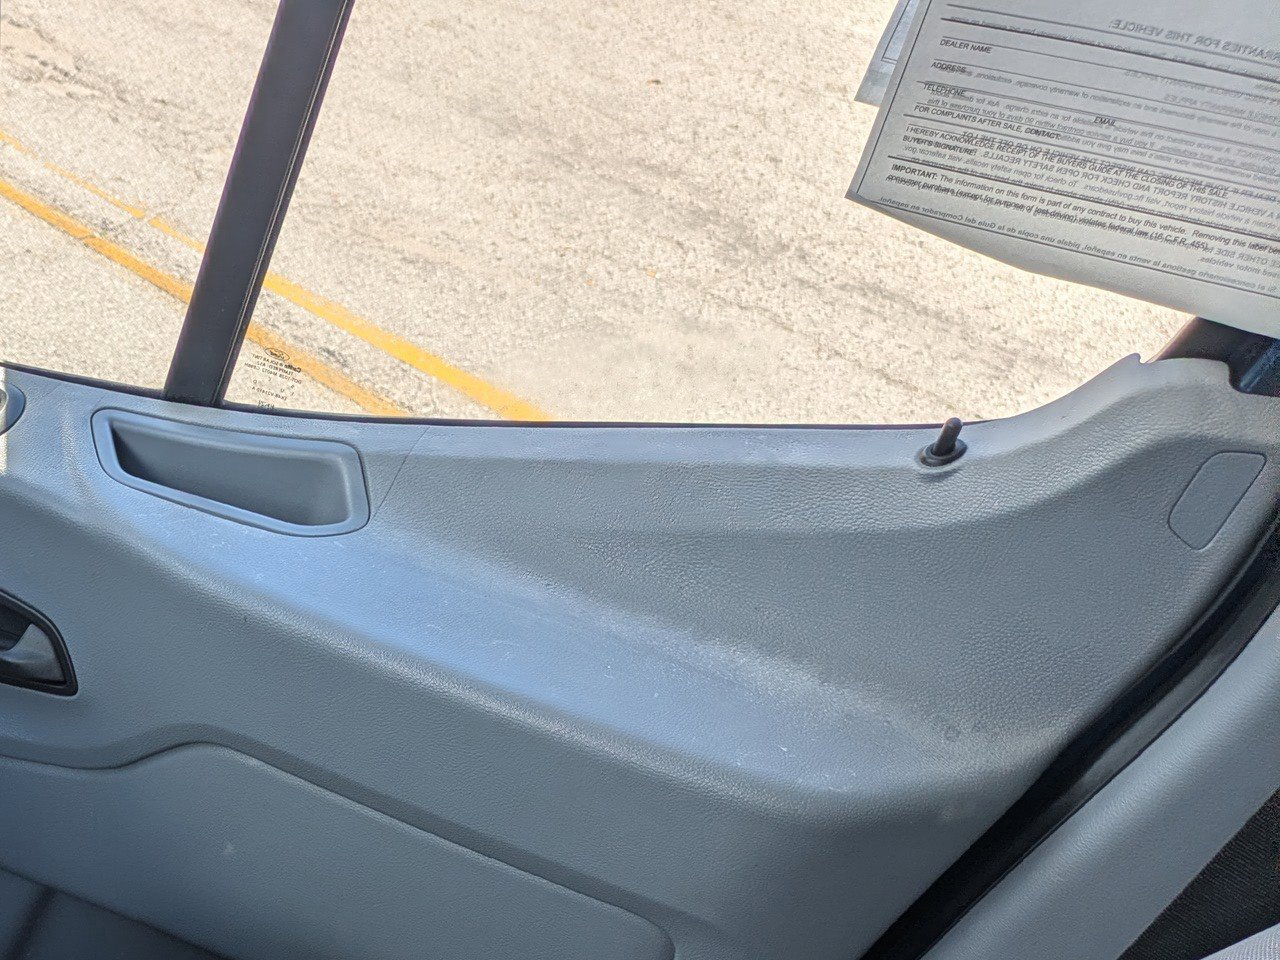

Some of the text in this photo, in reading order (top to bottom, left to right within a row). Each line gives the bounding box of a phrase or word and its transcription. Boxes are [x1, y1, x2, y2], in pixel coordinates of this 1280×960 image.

[940, 39, 991, 54] DEALER NAME
[931, 62, 966, 73] ADDRESS
[923, 83, 966, 97] TELEPHONE
[914, 105, 929, 114] FOR
[931, 108, 977, 122] COMPLAINTS
[977, 118, 1001, 128] AFTER
[1003, 122, 1023, 133] SALE,
[1094, 116, 1116, 127] EMAIL
[910, 126, 939, 138] HEREBY
[939, 132, 994, 149] ACKNOWLEDGE
[996, 143, 1028, 157] RECEIPT
[1028, 150, 1038, 159] OF
[1040, 152, 1054, 162] THE
[1056, 155, 1086, 170] BUYERS
[1088, 162, 1112, 174] GUIDE
[1113, 167, 1122, 176] AT
[1124, 169, 1138, 180] THE
[1140, 173, 1174, 187] CLOSING
[1176, 180, 1186, 190] OF
[1188, 183, 1205, 194] THIS
[1207, 187, 1228, 199] SALE
[891, 163, 937, 180] IMPORTANT:
[940, 173, 952, 183] The
[954, 177, 993, 192] information
[1006, 188, 1018, 198] this
[1020, 192, 1037, 202] form
[1039, 196, 1045, 204] is
[1046, 197, 1062, 209] part
[1062, 201, 1071, 210] of
[1072, 204, 1085, 214] any
[1087, 206, 1117, 220] contract
[1119, 214, 1126, 222] to
[1127, 215, 1142, 226] buy
[1143, 219, 1157, 228] this
[1159, 221, 1186, 235] vehicle.
[1191, 228, 1230, 246] Removing
[1232, 237, 1245, 248] this
[1247, 240, 1267, 252] label
